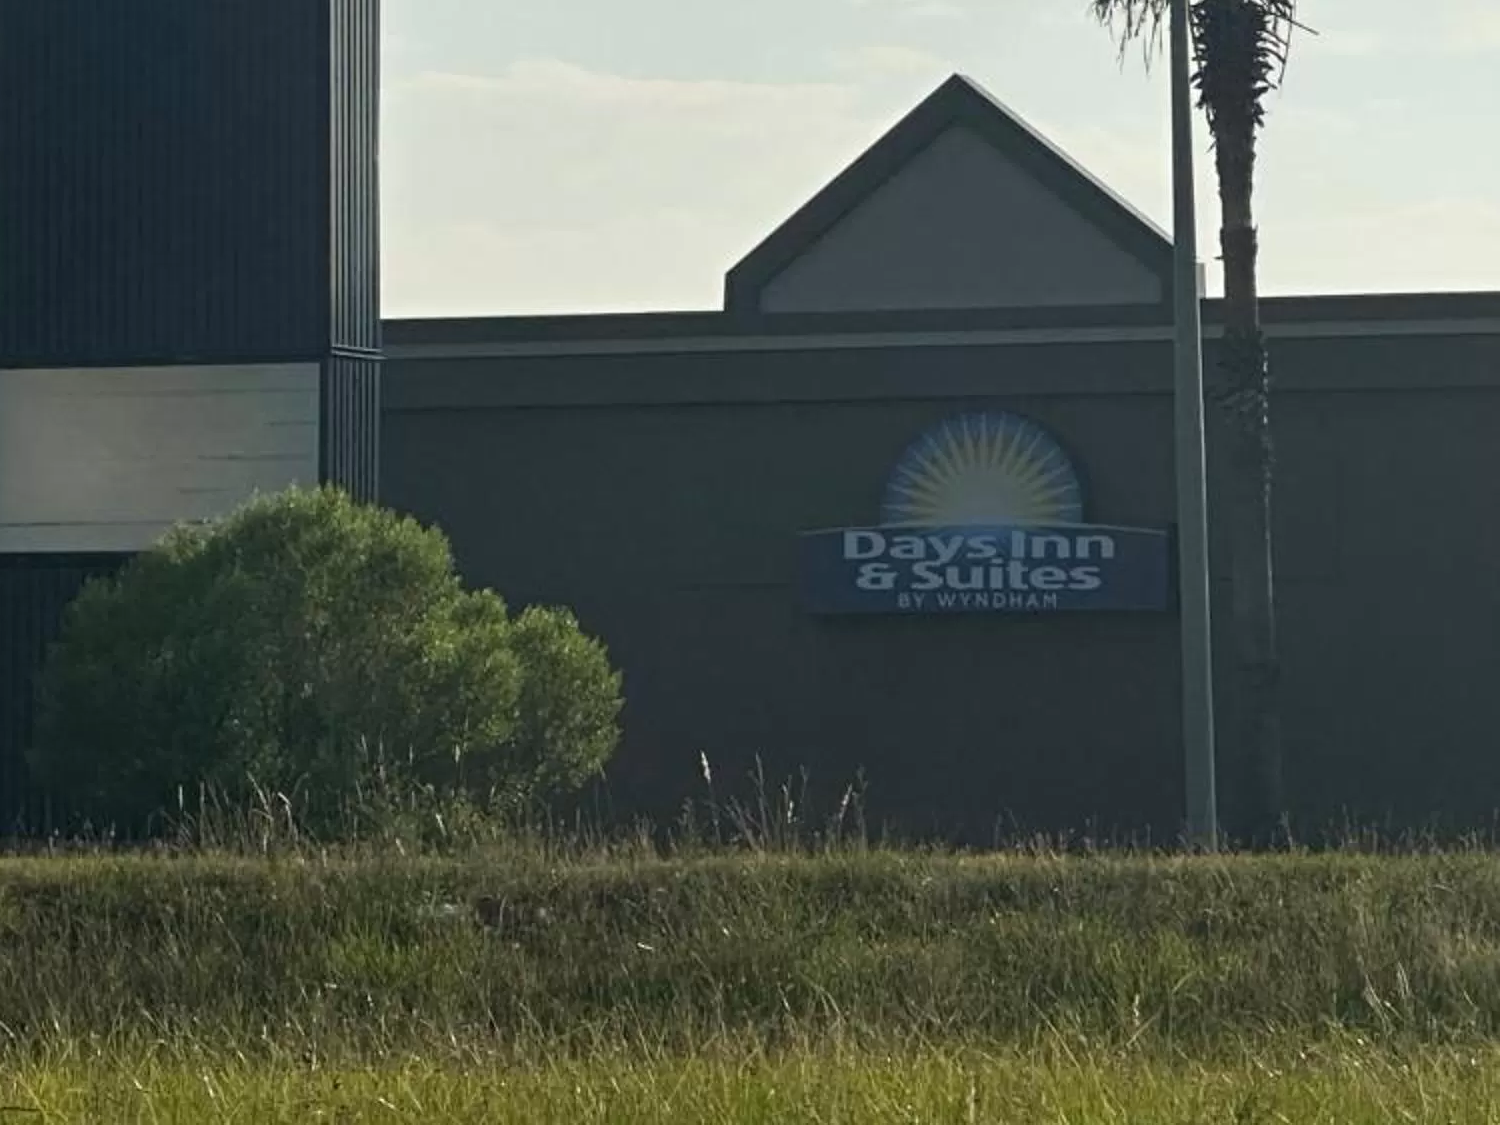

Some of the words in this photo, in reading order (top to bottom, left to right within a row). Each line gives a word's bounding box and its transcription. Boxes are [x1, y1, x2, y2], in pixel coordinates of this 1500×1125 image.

[843, 530, 996, 564] Days
[1011, 530, 1115, 559] Inn
[855, 562, 898, 590] &
[911, 557, 1101, 590] Suites
[897, 593, 925, 609] BY
[938, 593, 1058, 609] WYNDHAM
